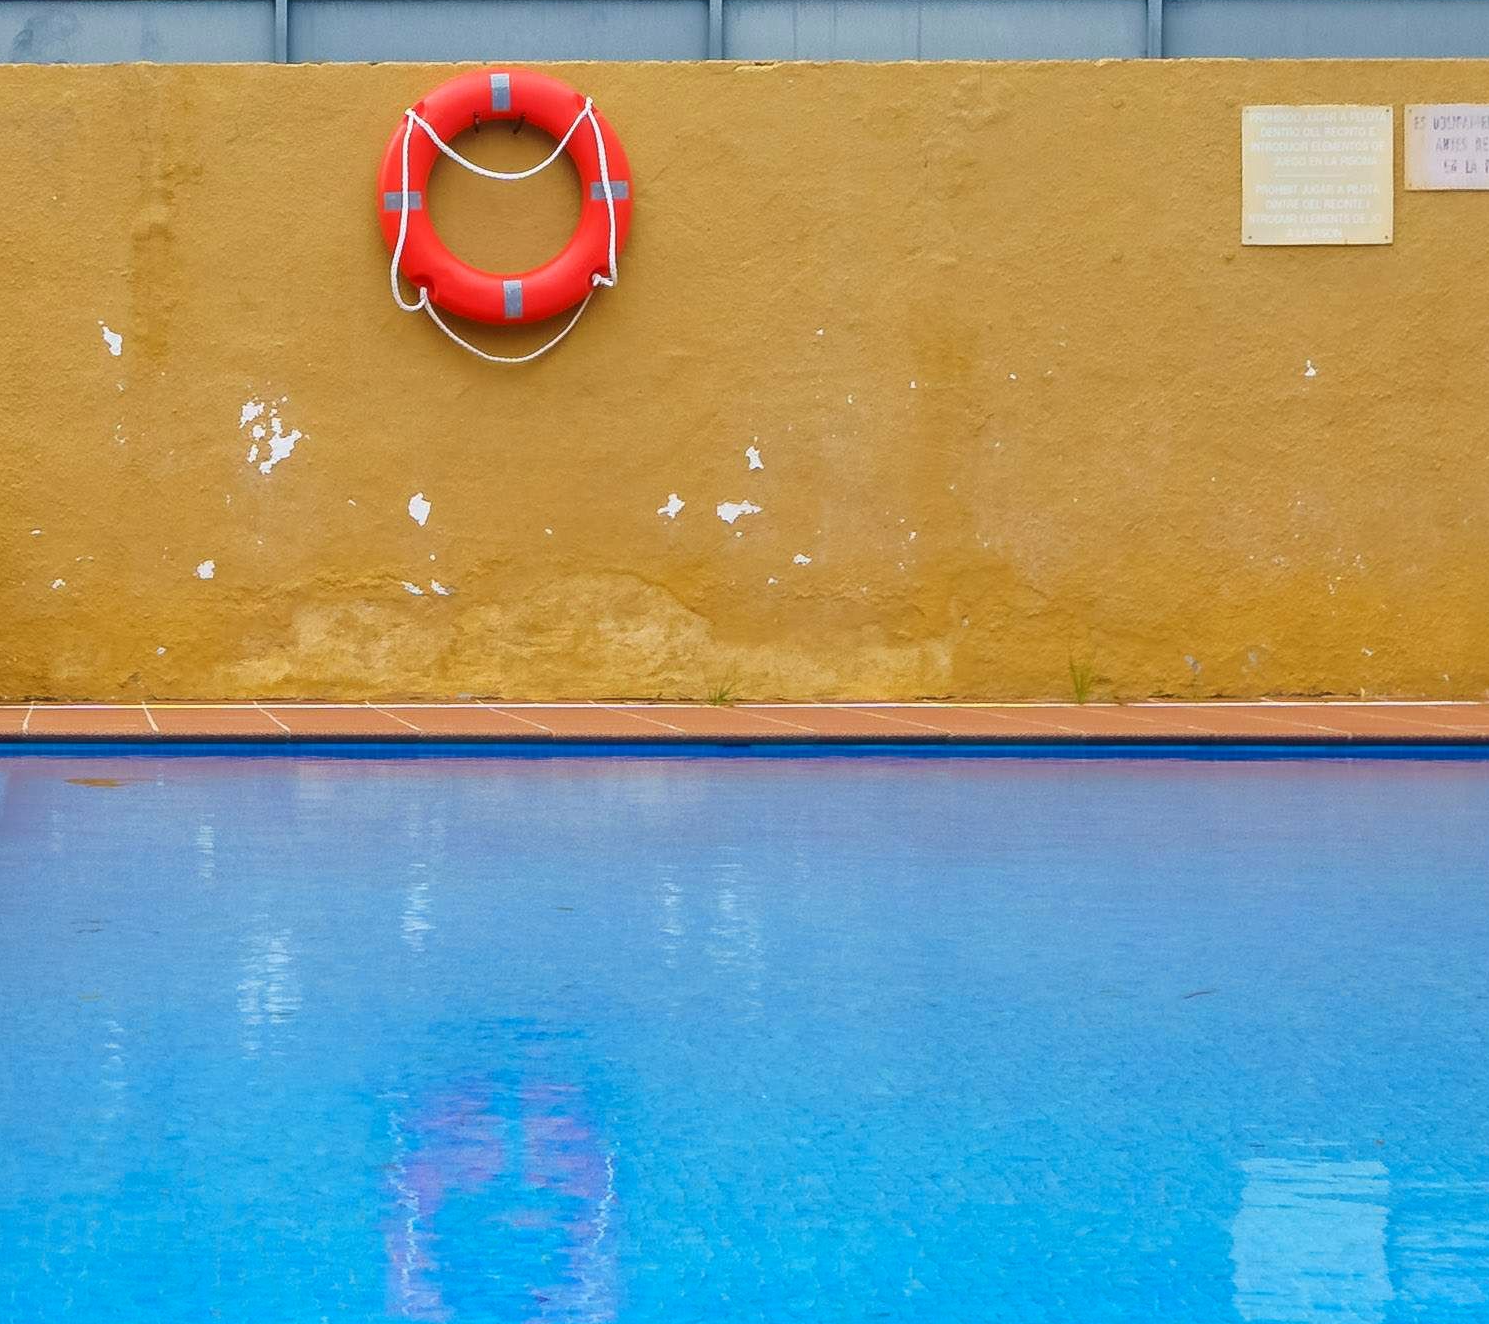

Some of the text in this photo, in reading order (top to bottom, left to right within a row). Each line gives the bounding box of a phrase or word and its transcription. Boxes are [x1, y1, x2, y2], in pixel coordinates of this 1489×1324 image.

[1304, 112, 1337, 123] JUGAR
[1349, 111, 1389, 123] PELOTA
[1414, 115, 1426, 130] ES
[1302, 126, 1321, 137] DEL
[1435, 137, 1468, 152] ANTES
[1475, 137, 1489, 152] DE
[1465, 159, 1478, 174] LA
